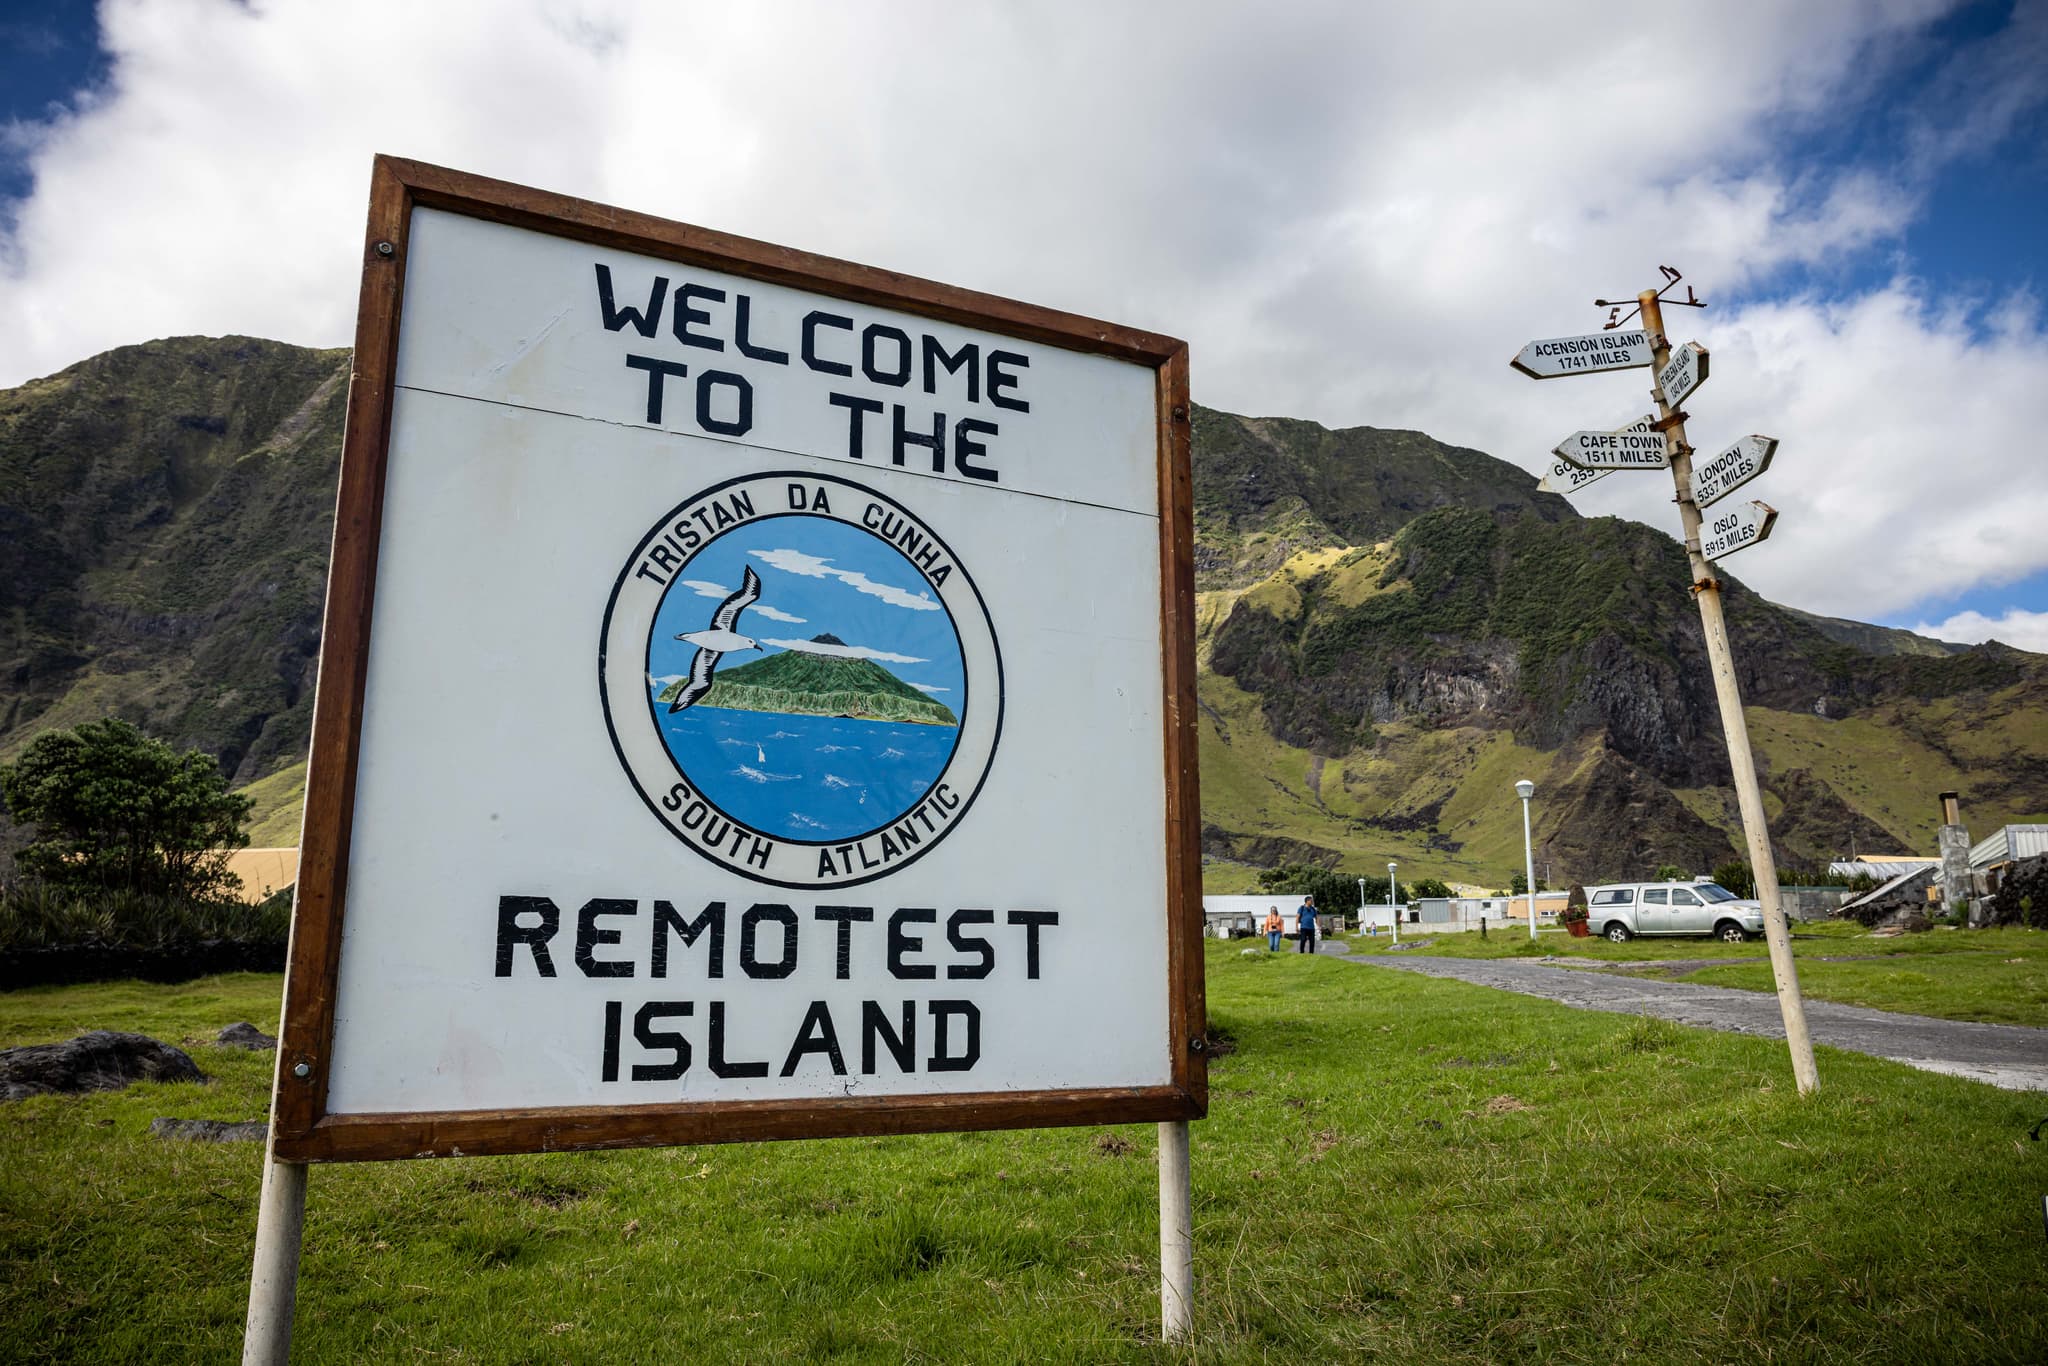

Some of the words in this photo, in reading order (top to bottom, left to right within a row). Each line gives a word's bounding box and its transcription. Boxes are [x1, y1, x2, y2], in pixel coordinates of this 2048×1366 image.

[595, 263, 1030, 414] WELCOME
[1535, 339, 1598, 357] ACENSION
[1601, 334, 1645, 349] ISLAND
[1558, 355, 1588, 369] 1741
[1590, 350, 1631, 366] MILES
[1677, 369, 1691, 391] MILES
[626, 353, 753, 437] TO
[829, 391, 999, 483] THE
[1580, 435, 1618, 448] CAPE
[1621, 436, 1663, 449] TOWN
[1584, 450, 1615, 463] 1511
[1620, 450, 1662, 463] MILES
[1697, 480, 1720, 503] 5337
[1721, 458, 1754, 487] MILES
[1699, 447, 1742, 484] LONDON
[636, 489, 756, 588] TRISTAN
[787, 483, 831, 513] DA
[862, 502, 954, 588] CUNHA
[1705, 537, 1725, 556] 5915
[1726, 523, 1755, 548] MILES
[1713, 513, 1738, 535] OSLO
[661, 781, 774, 869] SOUTH
[817, 783, 961, 878] ATLANTIC
[494, 895, 1059, 980] REMOTEST
[602, 999, 981, 1082] ISLAND
